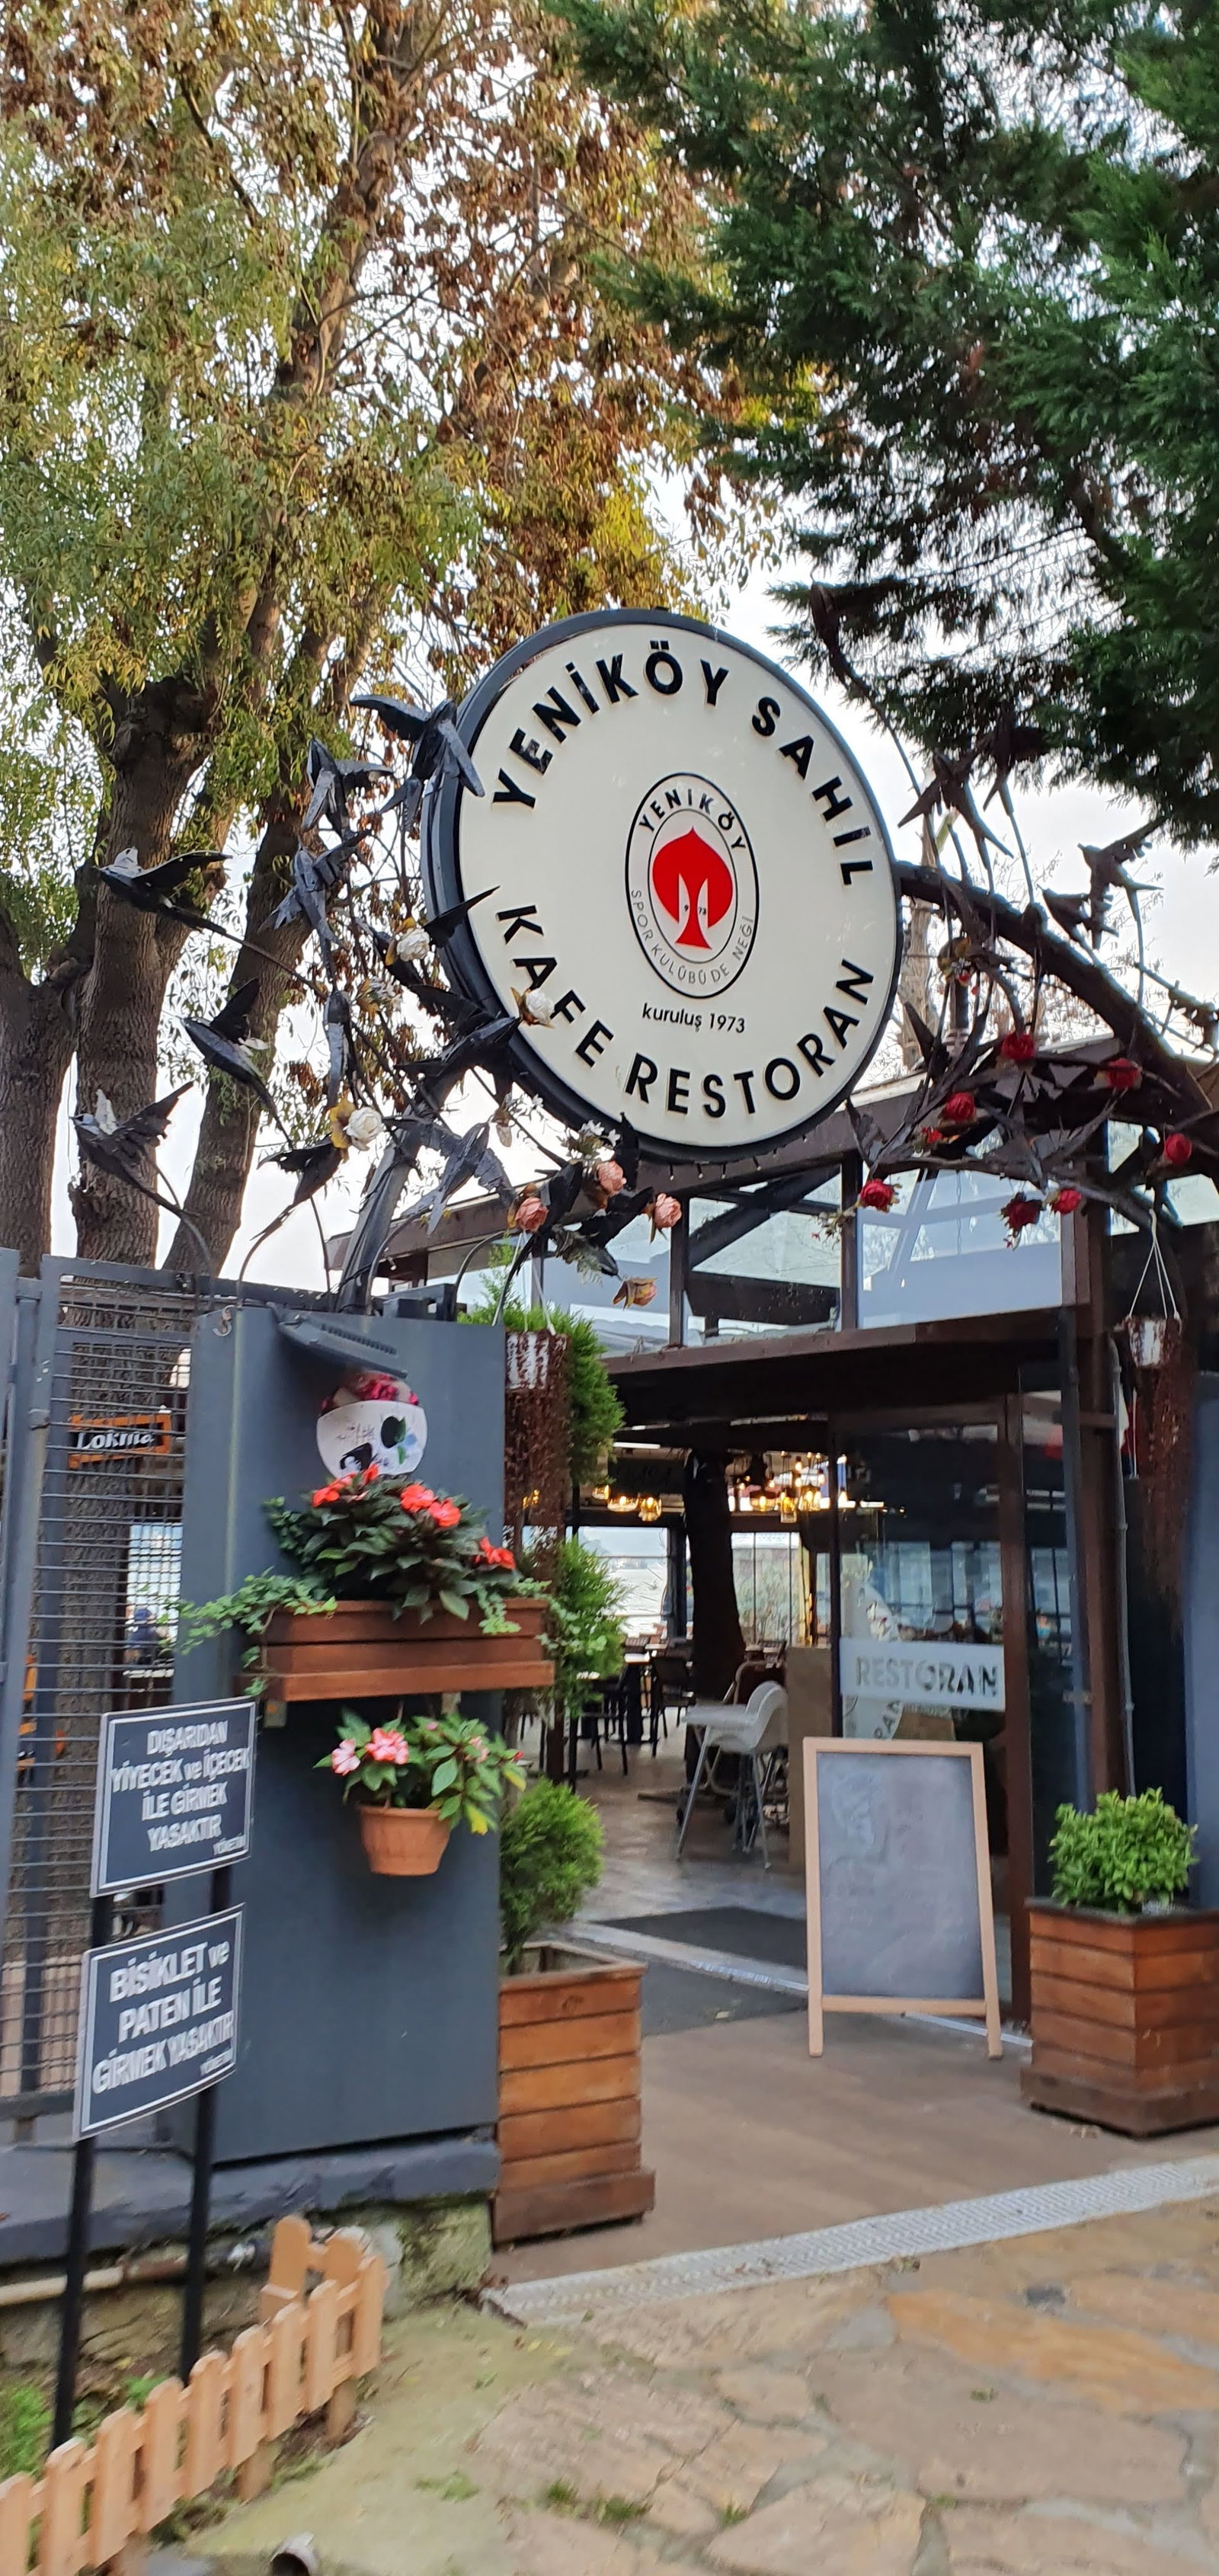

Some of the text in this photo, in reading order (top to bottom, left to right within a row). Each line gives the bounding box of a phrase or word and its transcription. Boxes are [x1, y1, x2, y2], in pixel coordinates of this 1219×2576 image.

[492, 640, 728, 809] YENİKÖY
[638, 788, 746, 850] YENİKÖY
[631, 890, 654, 942] SPOR
[495, 905, 874, 1118] KAFE RESTORAN
[642, 1003, 745, 1034] kuruluş 1973
[856, 1656, 999, 1698] RESTORAN
[110, 1747, 251, 1793] YİYECEK ve İÇECEK
[142, 1781, 228, 1821] İLE GİRMEK
[110, 1941, 230, 2003] BİSİKLET ve
[118, 1976, 223, 2043] PATEN İLE
[92, 2039, 169, 2094] GİRMEK
